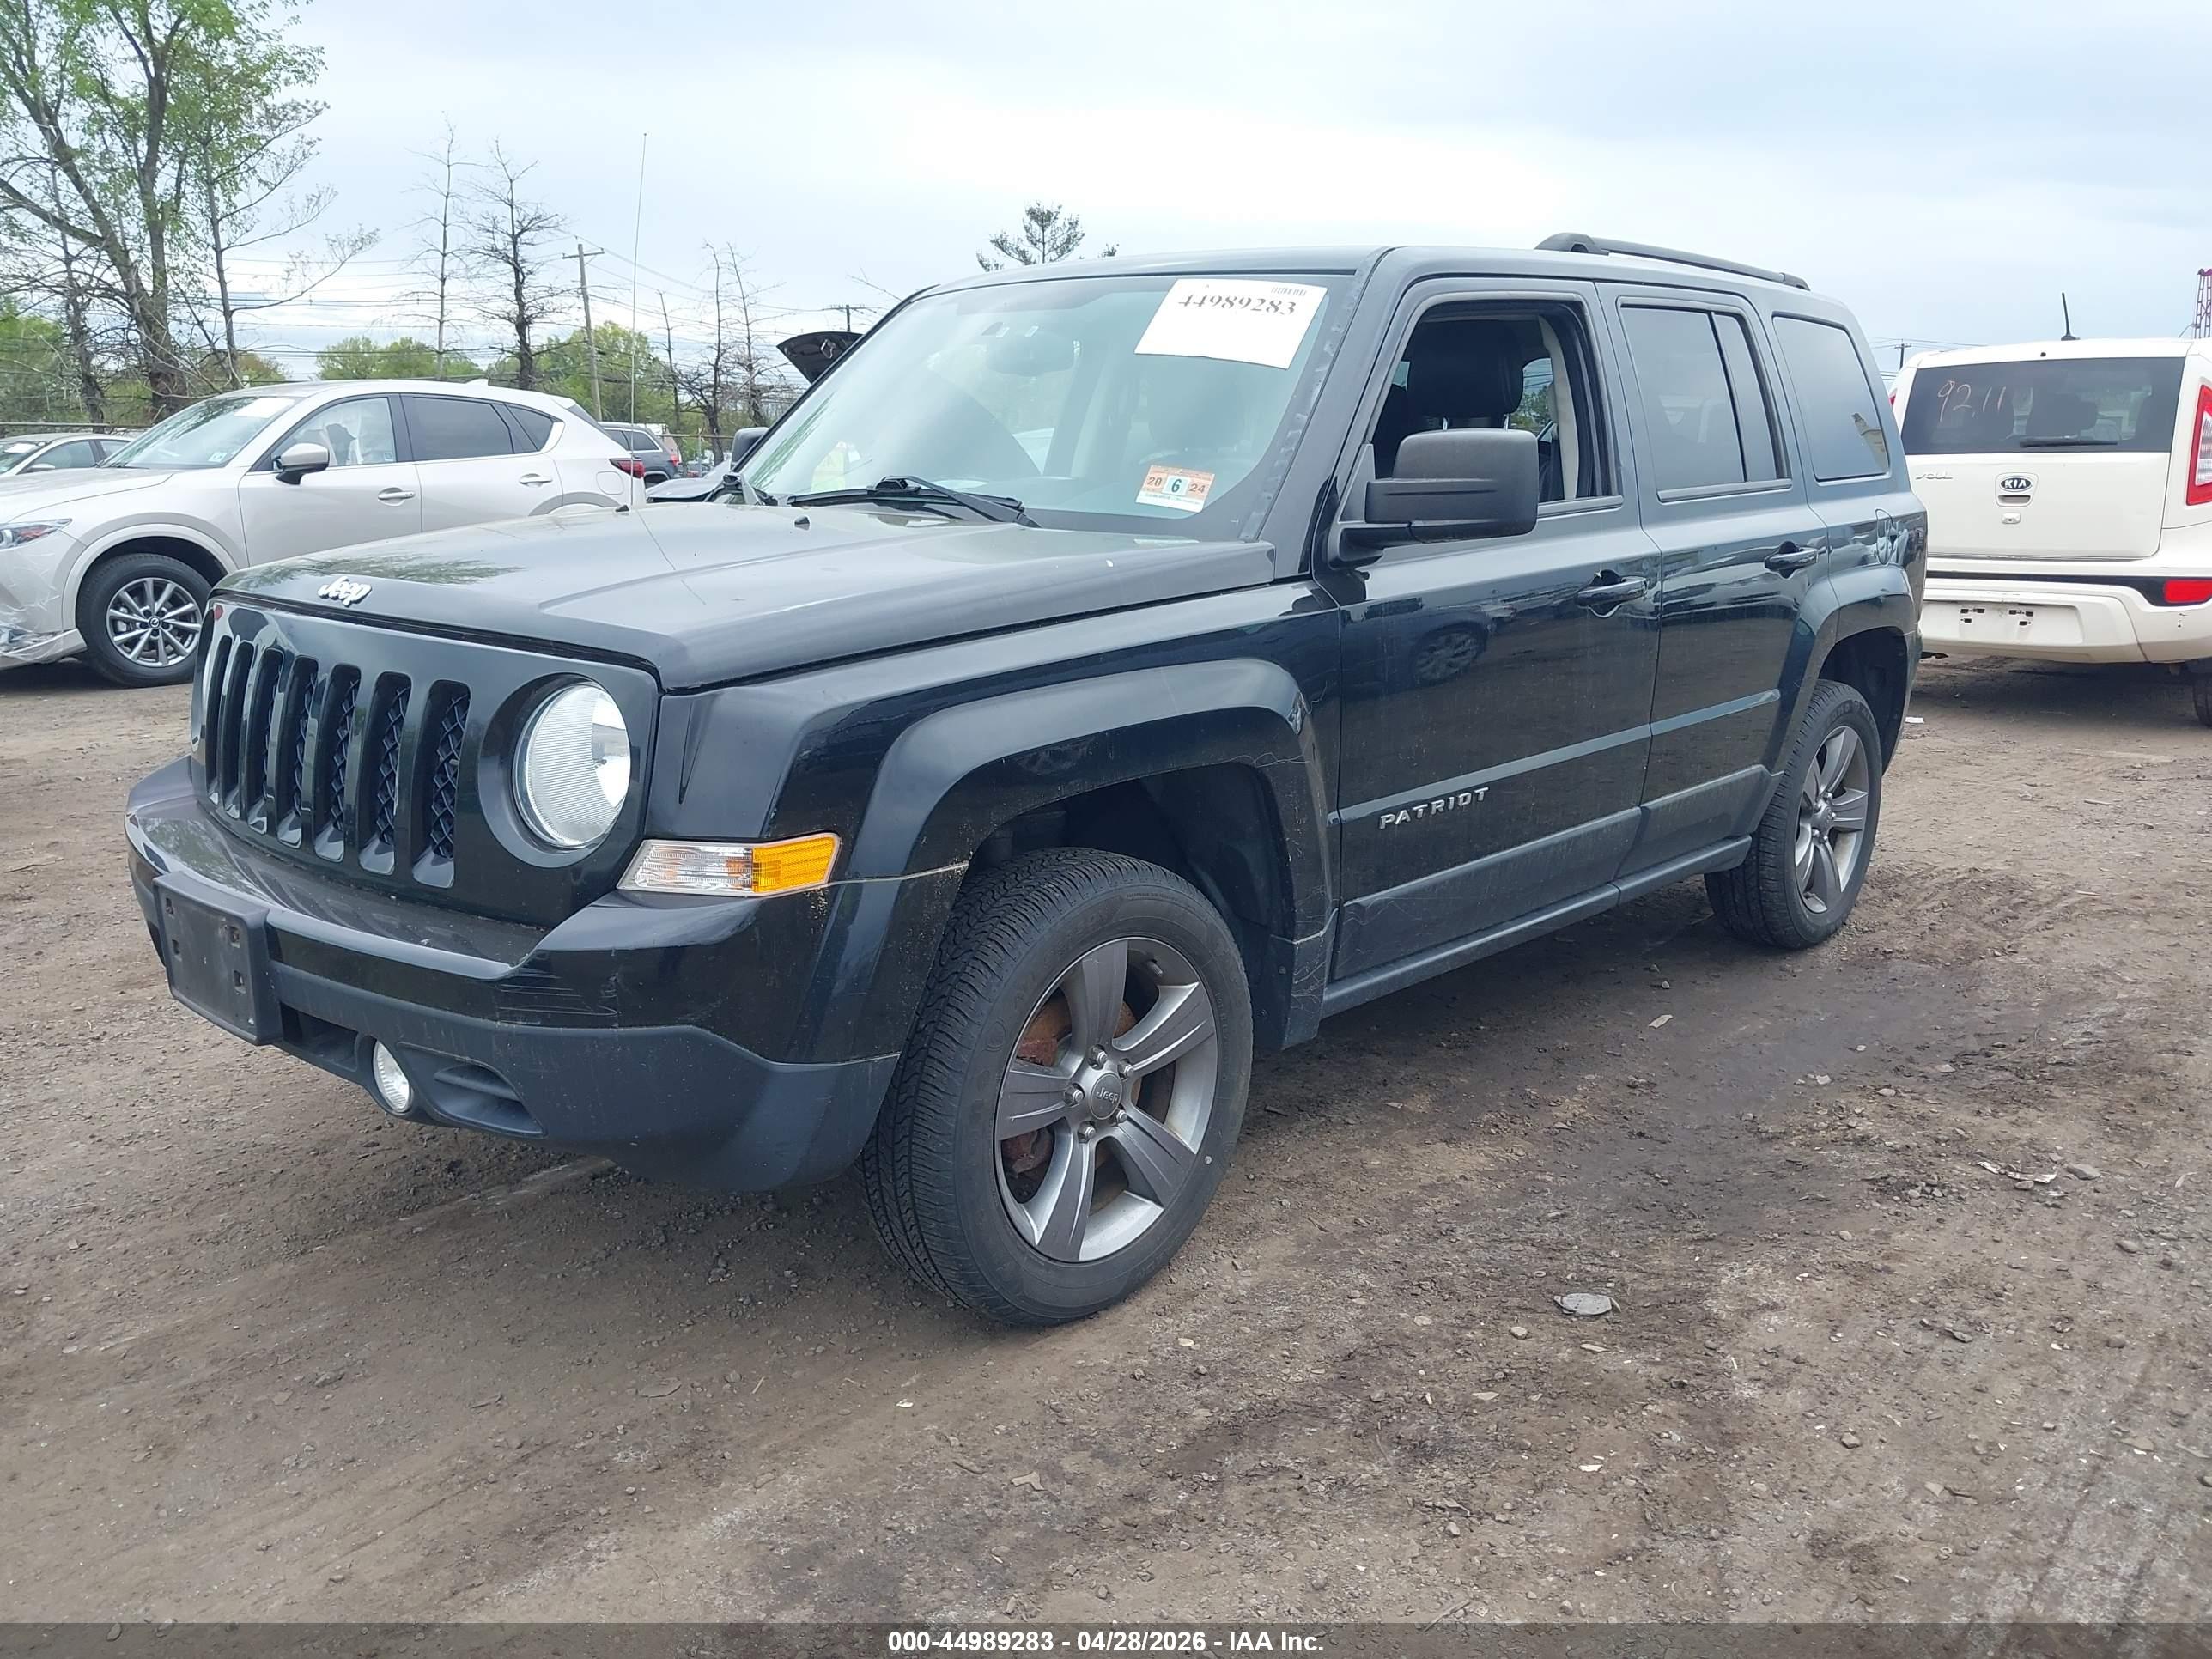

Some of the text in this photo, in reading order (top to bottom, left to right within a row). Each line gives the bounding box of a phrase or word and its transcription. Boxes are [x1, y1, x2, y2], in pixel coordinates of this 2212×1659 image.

[1177, 294, 1297, 315] 44989283
[1146, 477, 1206, 494] 20 6 24
[2003, 478, 2028, 489] KIA
[317, 575, 373, 608] Jeep
[1379, 787, 1489, 830] PATRIOT
[1096, 1086, 1119, 1105] Jeep
